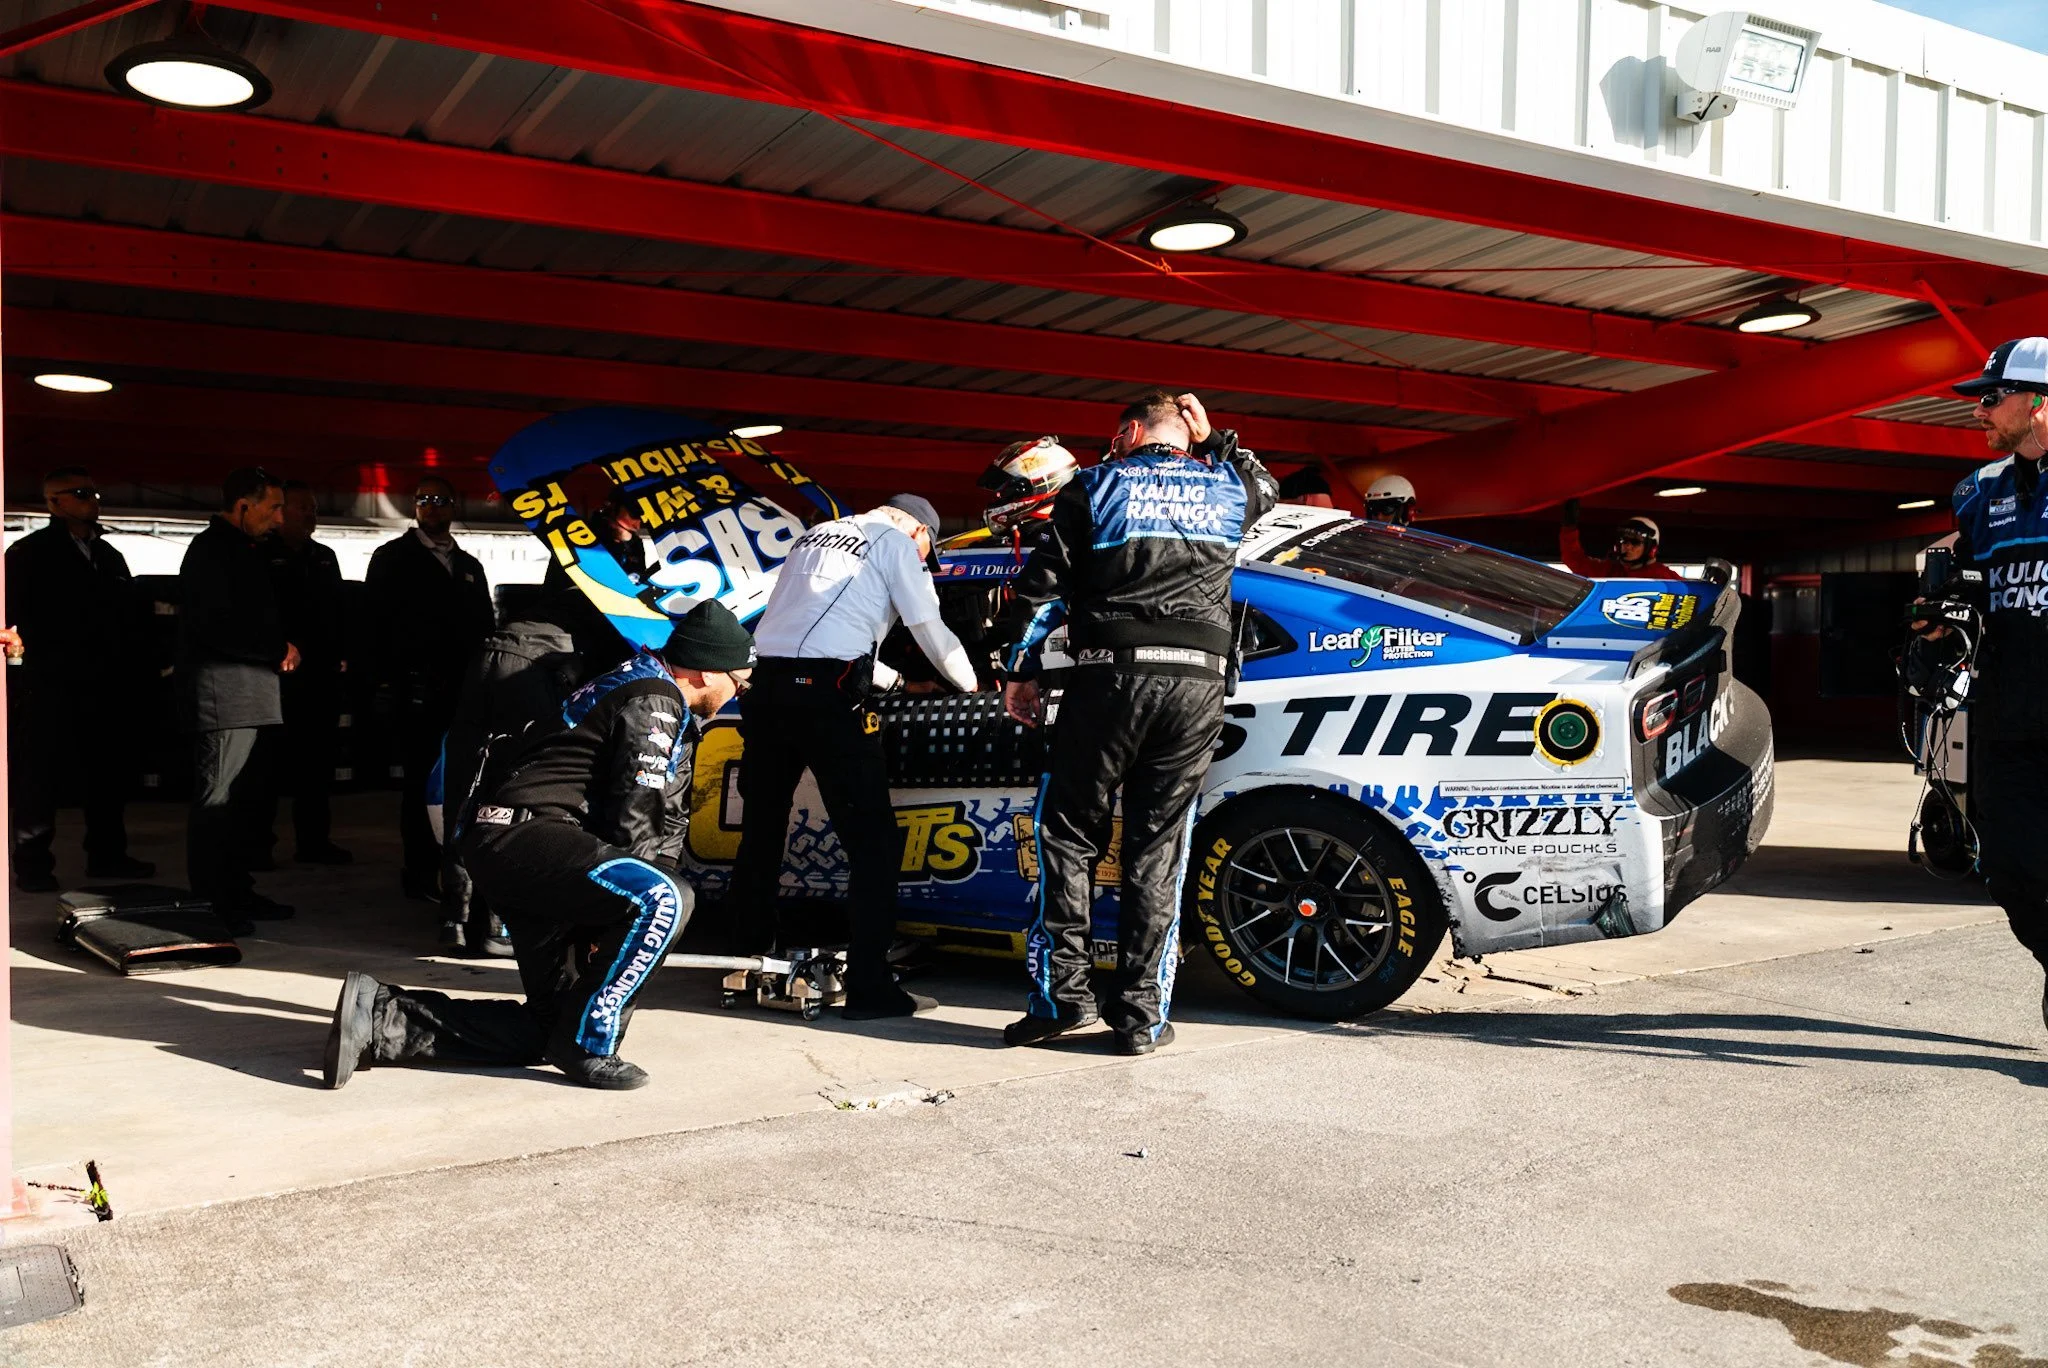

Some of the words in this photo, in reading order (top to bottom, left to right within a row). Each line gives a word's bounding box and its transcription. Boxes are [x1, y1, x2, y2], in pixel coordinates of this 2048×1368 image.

[1129, 483, 1206, 503] KAULIG
[1126, 500, 1207, 521] RACING
[985, 564, 1024, 576] DILLO
[1309, 627, 1364, 653] Leaf
[1383, 627, 1444, 646] Filter
[1383, 645, 1415, 653] GUTTER
[1383, 650, 1433, 660] PROTECTION
[1280, 692, 1558, 757] TIRE
[1481, 785, 1499, 793] product
[1541, 783, 1561, 791] Nicotine
[1573, 782, 1596, 790] addictive
[1442, 805, 1623, 843] GRIZZLY
[893, 806, 975, 872] TS
[1447, 844, 1527, 856] NICOTINE
[1523, 884, 1629, 905] CELSIUS
[1387, 876, 1416, 958] EAGLE
[601, 949, 655, 1012] RACING
